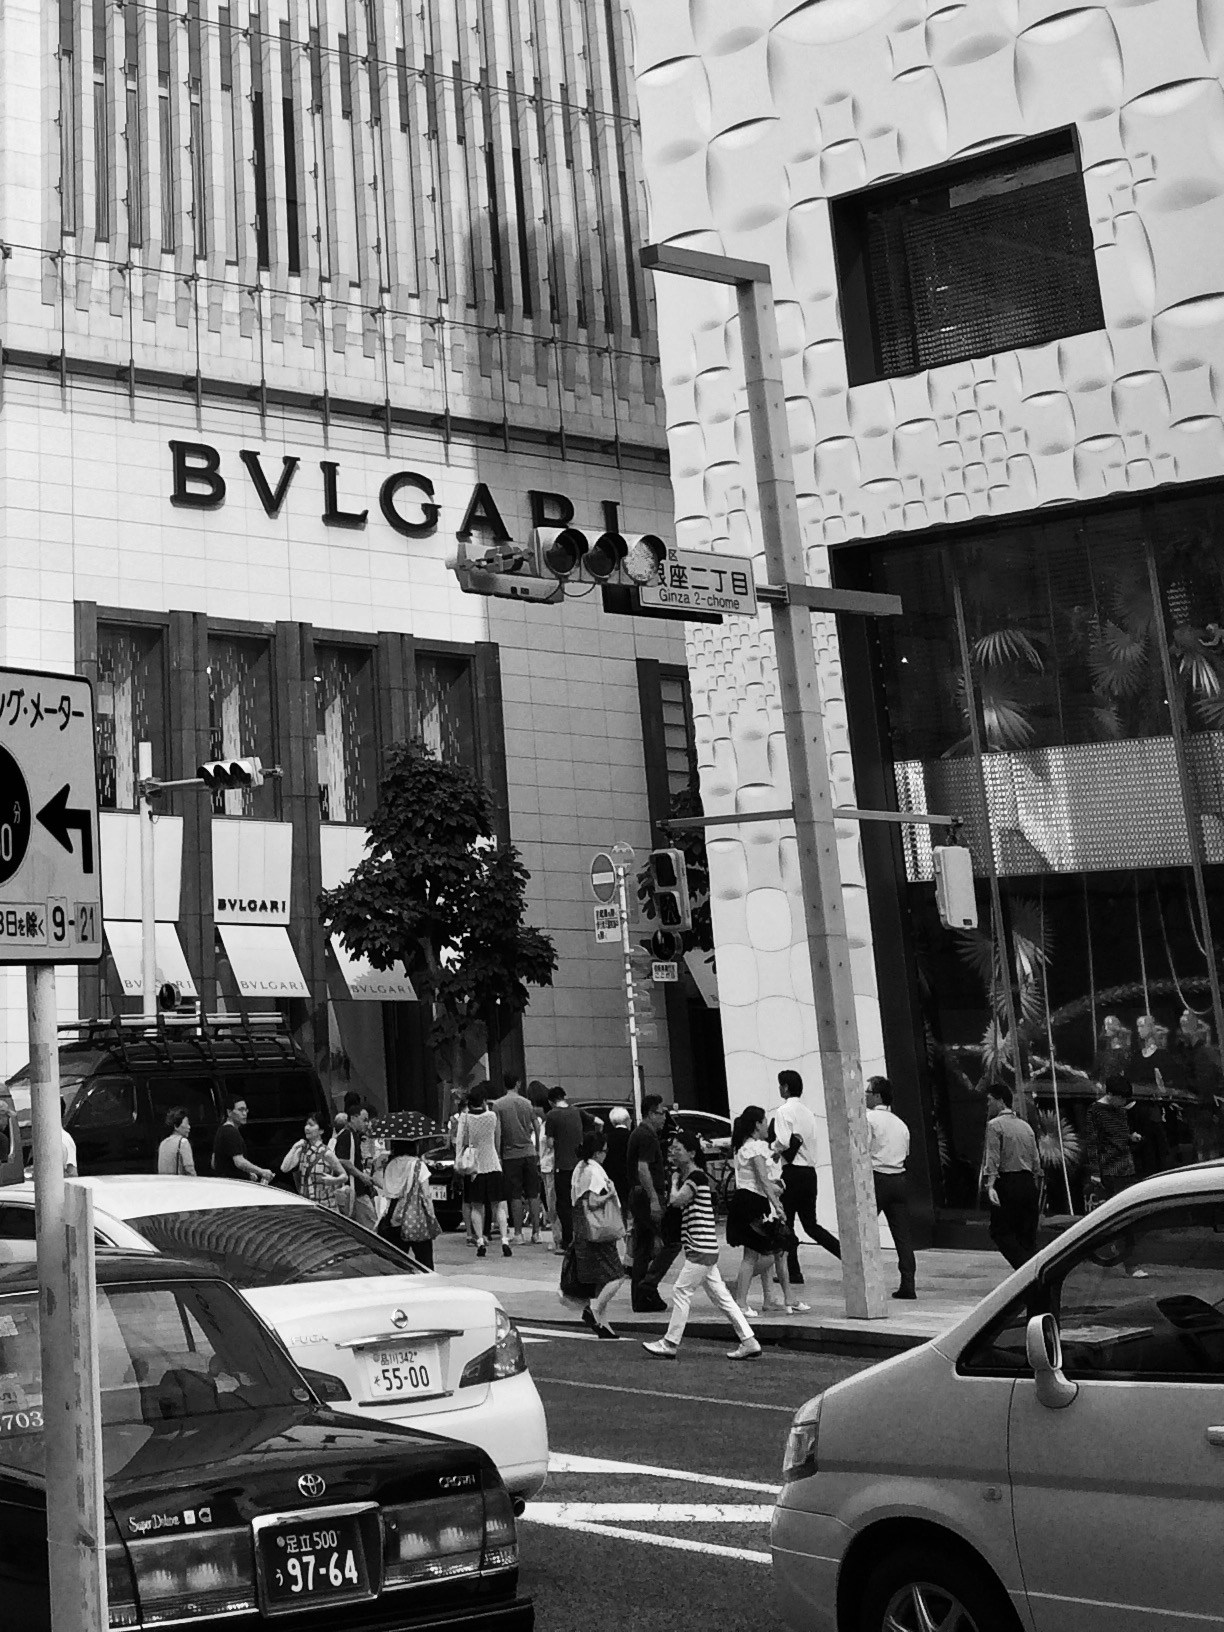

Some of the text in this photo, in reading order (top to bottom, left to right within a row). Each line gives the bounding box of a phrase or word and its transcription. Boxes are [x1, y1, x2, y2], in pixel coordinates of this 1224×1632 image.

[658, 587, 740, 610] Ginza 2-chome
[12, 800, 21, 824] 分
[217, 898, 286, 914] BVLGARI
[240, 979, 305, 991] BVLGARI
[351, 984, 413, 995] BVLGARI
[382, 1364, 430, 1391] 55-00
[287, 1549, 358, 1593] 97-64
